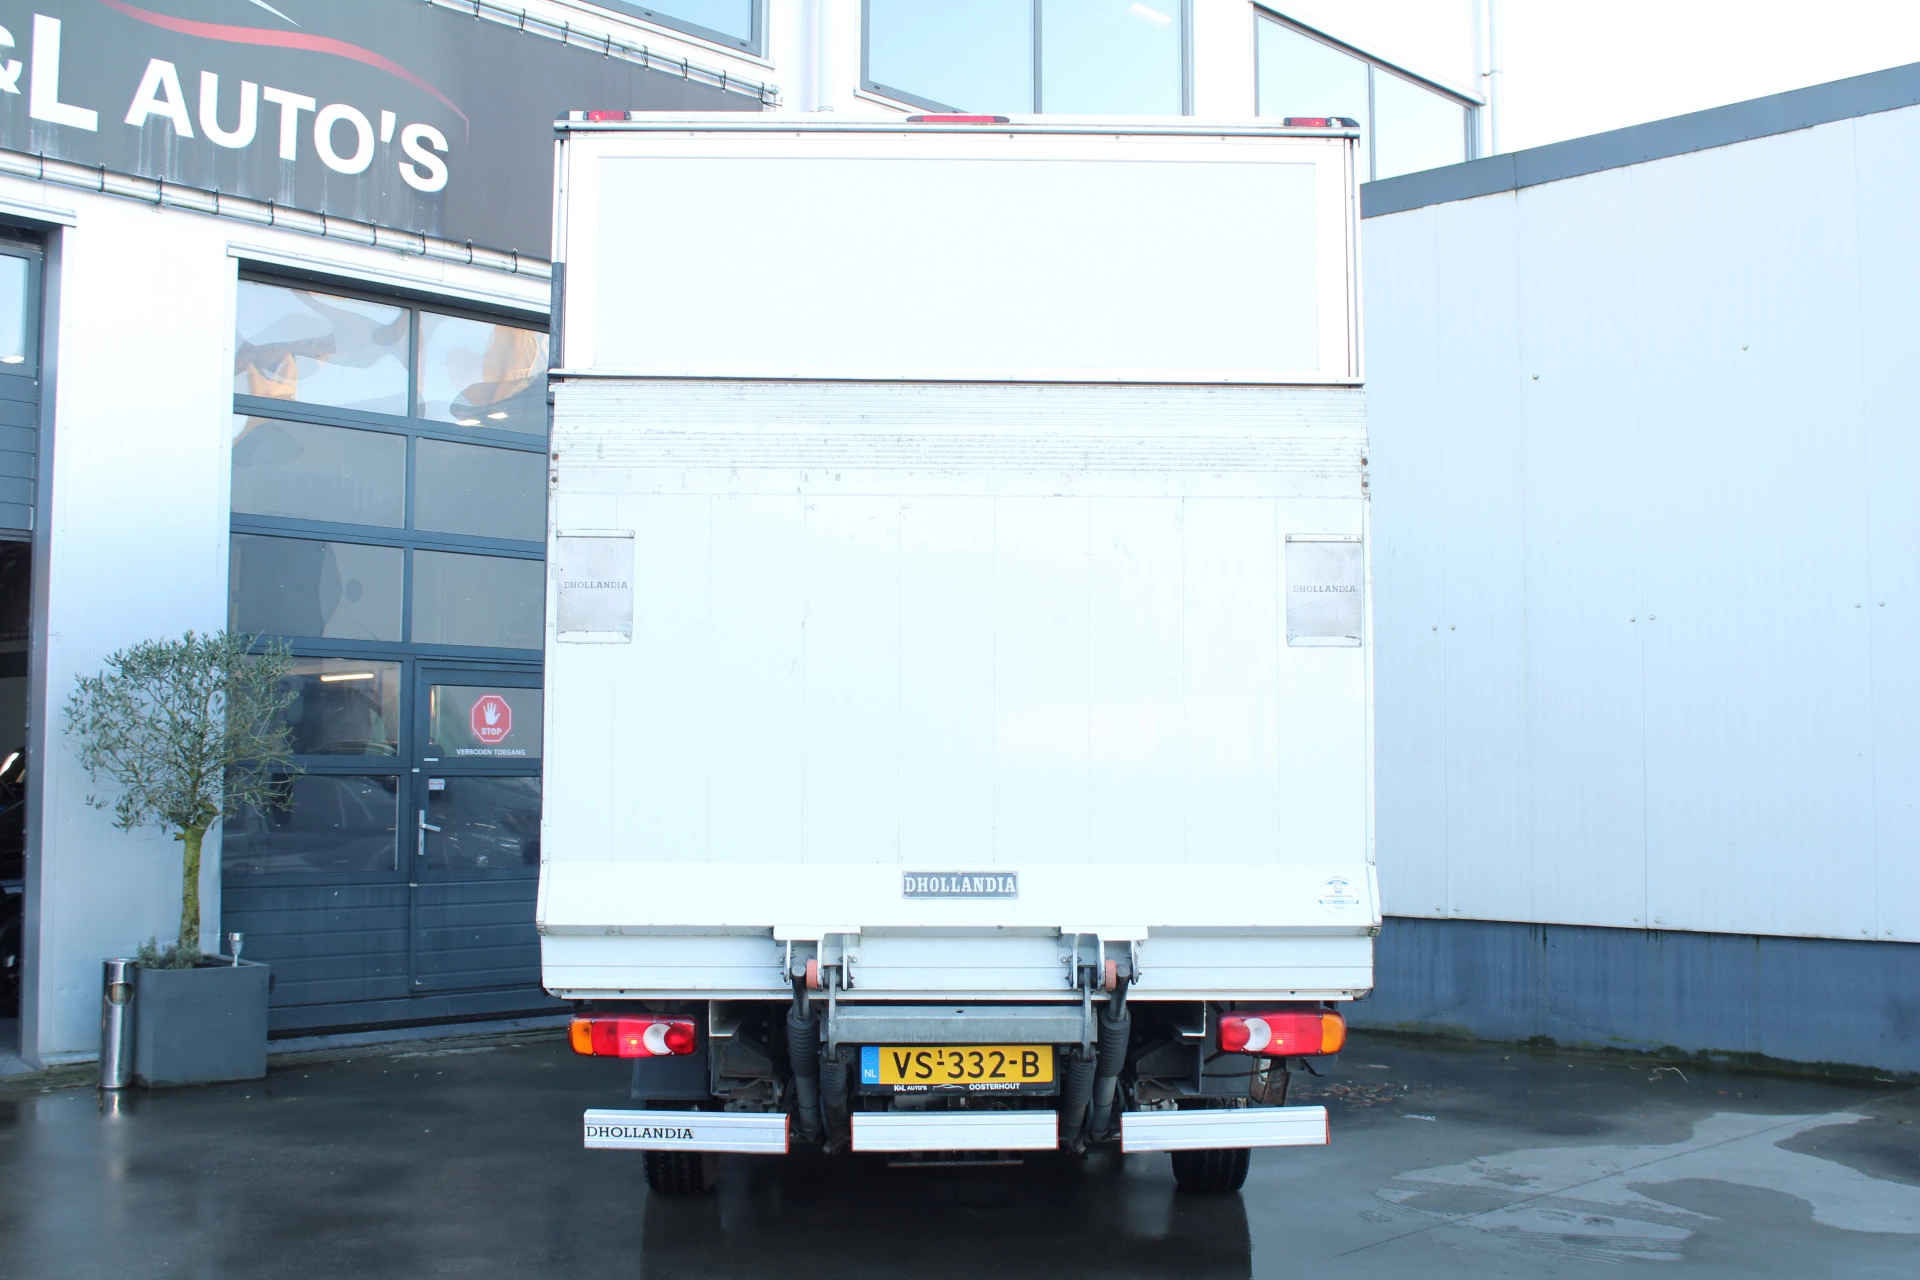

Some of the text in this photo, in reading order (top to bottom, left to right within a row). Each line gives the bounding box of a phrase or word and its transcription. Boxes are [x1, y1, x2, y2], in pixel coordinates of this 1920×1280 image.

[124, 58, 450, 193] AUTO'S
[564, 581, 628, 589] DHOLLANDIA
[1293, 585, 1356, 593] DHOLLANDIA
[456, 748, 492, 756] VERBODEN
[904, 877, 1017, 893] DHOLLANDIA
[864, 1069, 877, 1078] NL
[969, 1082, 1020, 1091] OOSTERHOUT
[586, 1126, 694, 1140] DHOLLANDIA
